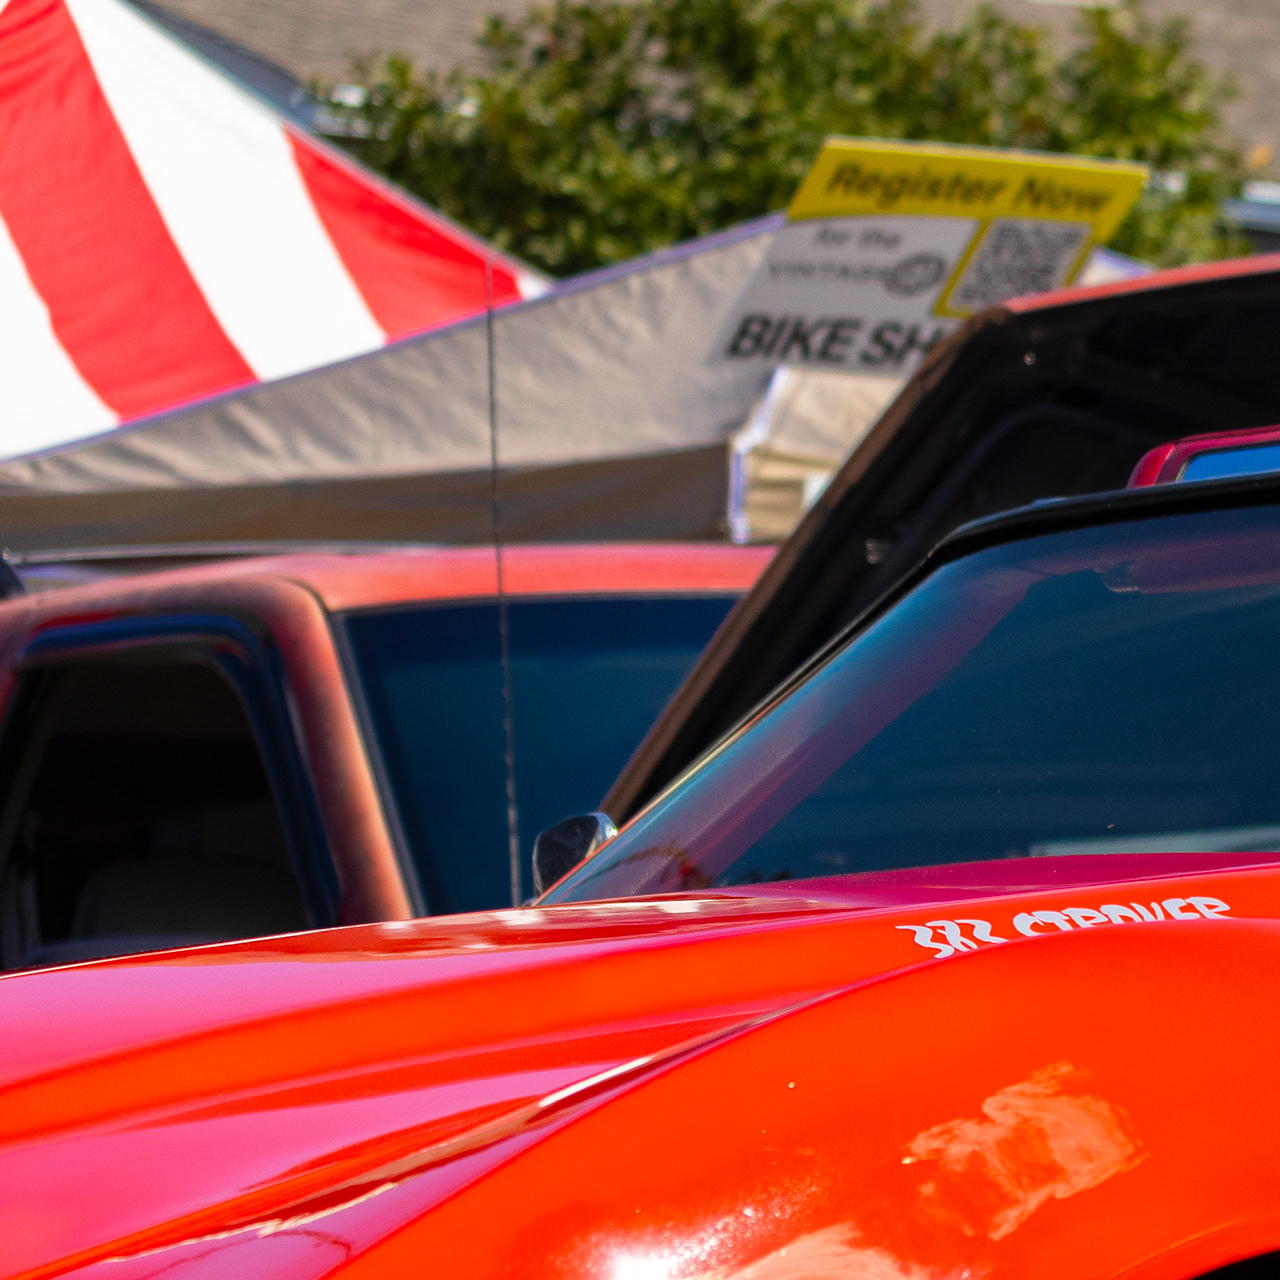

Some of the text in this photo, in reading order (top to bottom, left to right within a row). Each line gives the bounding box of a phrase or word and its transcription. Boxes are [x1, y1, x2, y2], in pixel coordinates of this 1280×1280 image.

[826, 161, 1111, 212] Register Now
[814, 226, 903, 249] for the
[726, 313, 862, 364] BIKE
